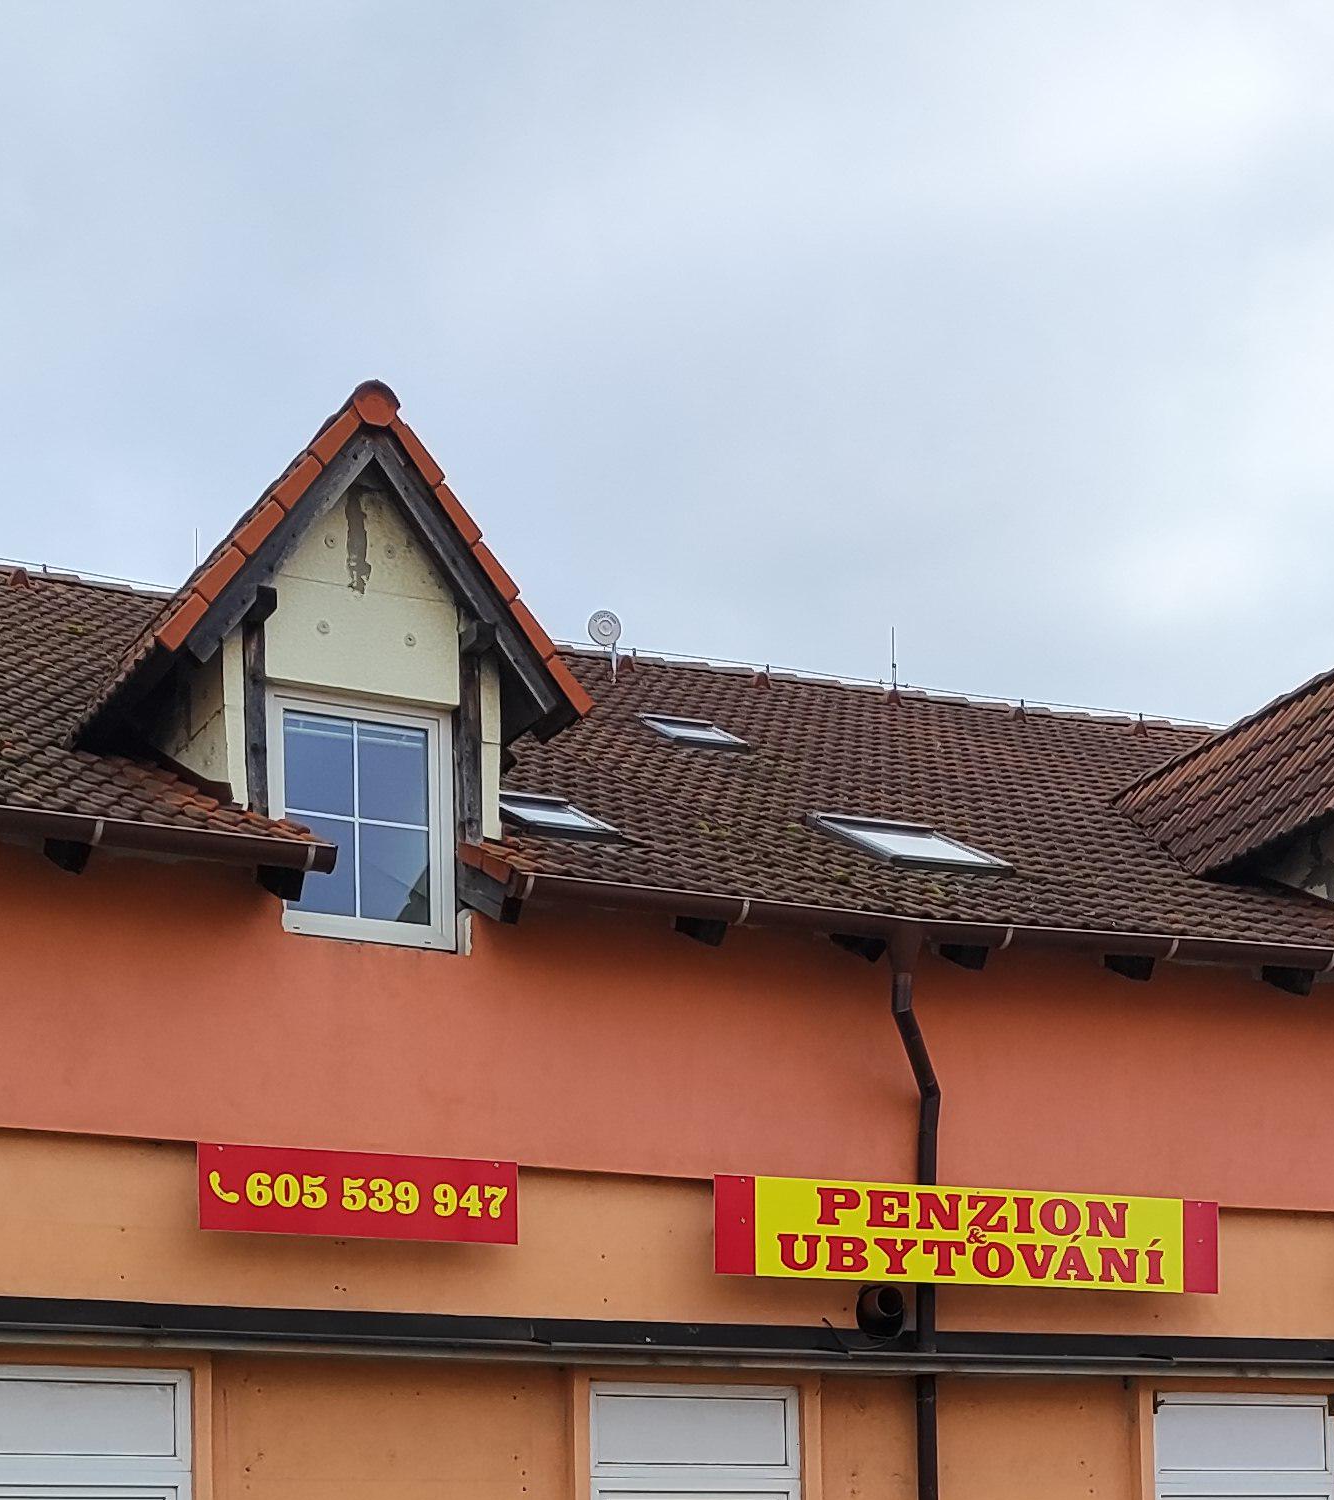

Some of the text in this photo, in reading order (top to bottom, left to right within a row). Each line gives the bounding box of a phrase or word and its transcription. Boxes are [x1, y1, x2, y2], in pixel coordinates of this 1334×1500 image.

[245, 1172, 508, 1219] 605 539 947
[815, 1186, 1129, 1239] PENZION
[777, 1232, 1165, 1286] UBYTOVÁNÍ
[966, 1225, 988, 1245] &
